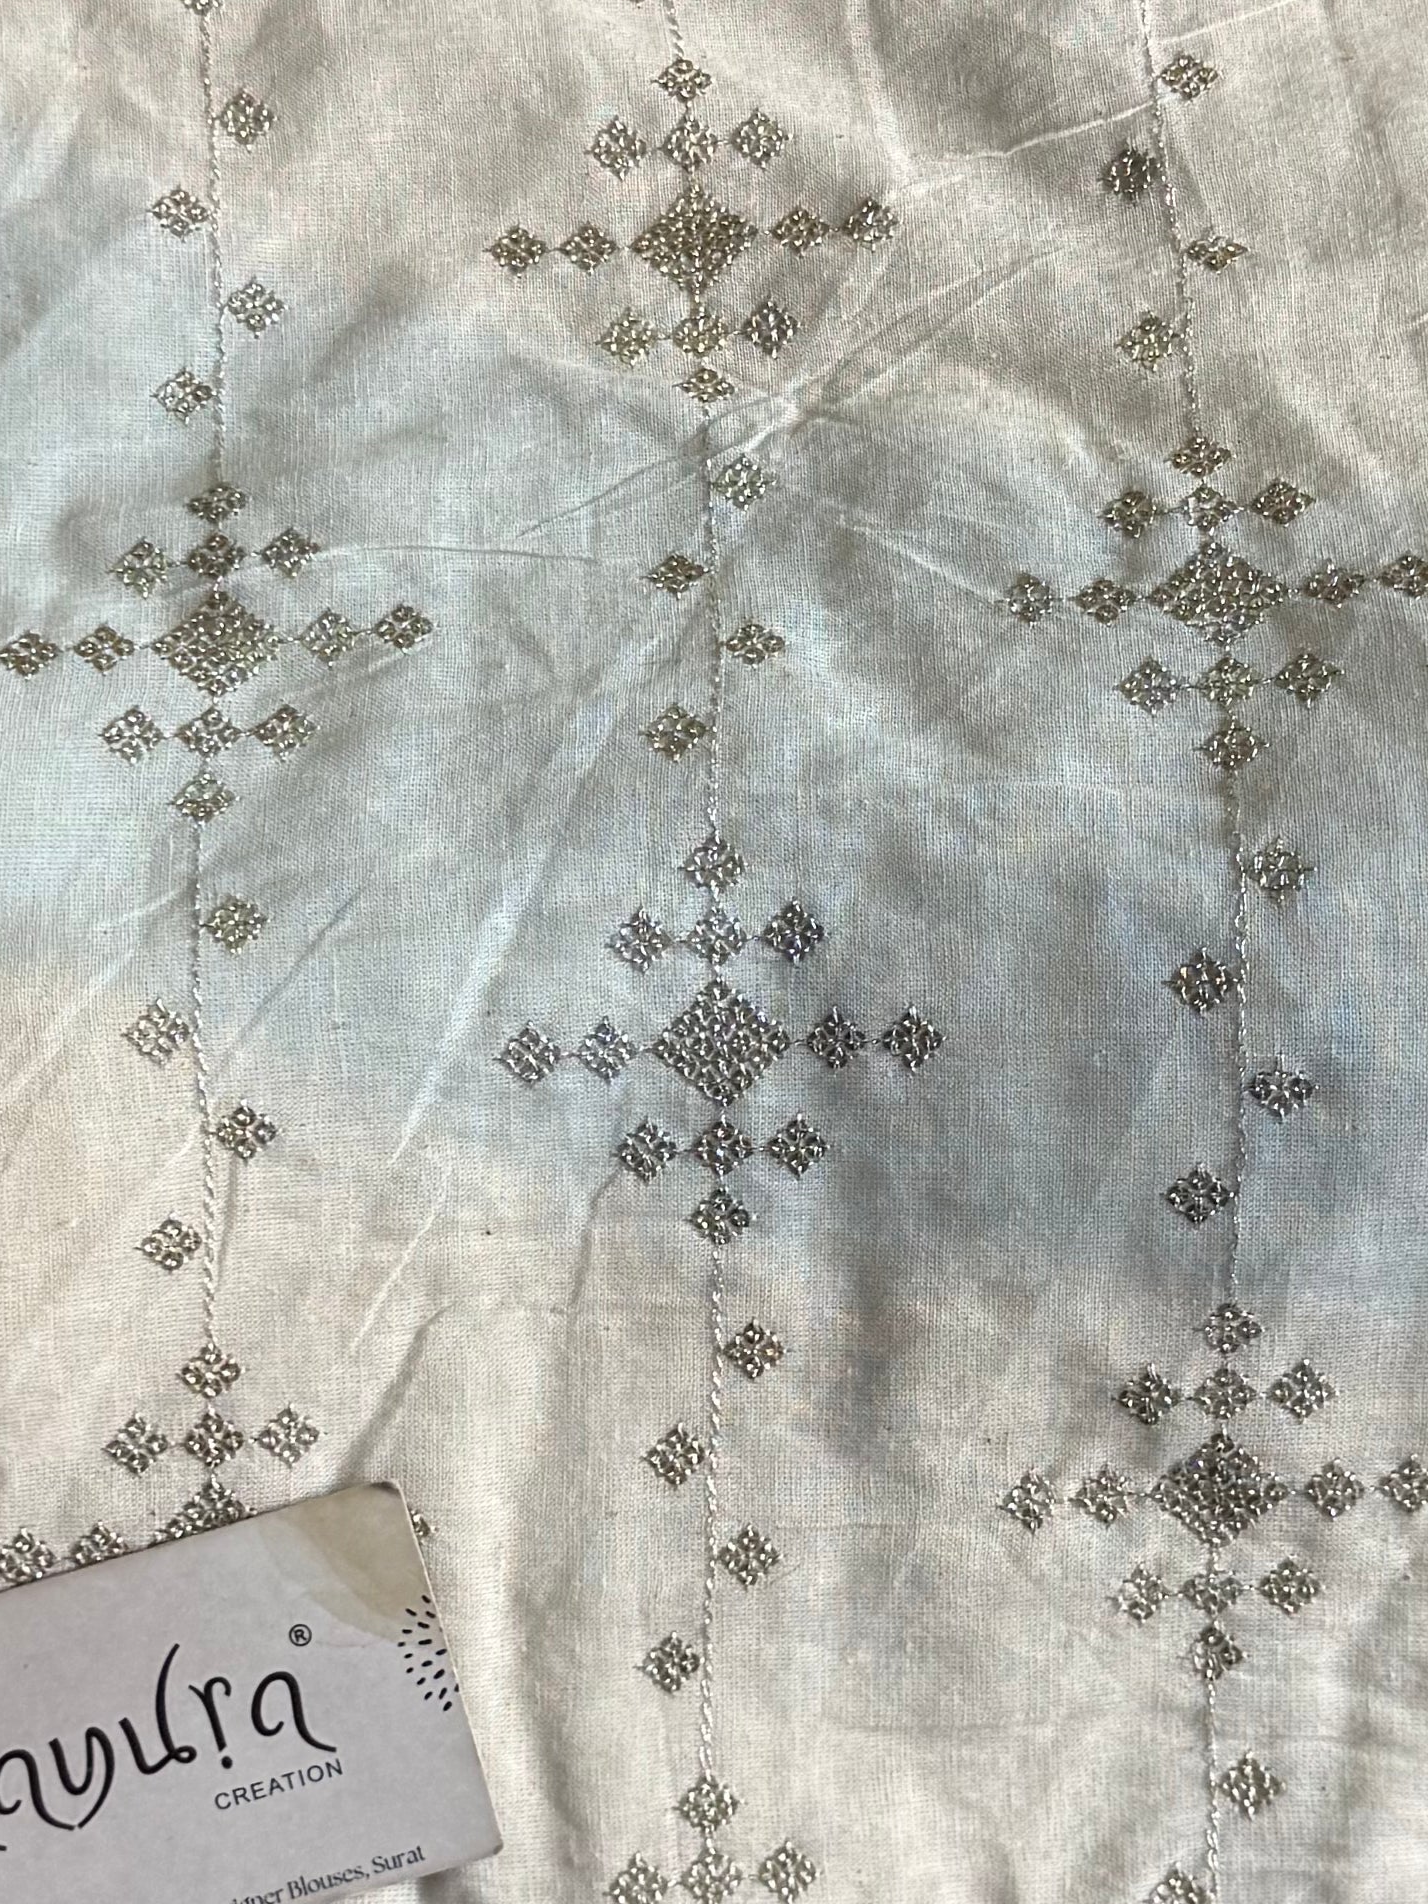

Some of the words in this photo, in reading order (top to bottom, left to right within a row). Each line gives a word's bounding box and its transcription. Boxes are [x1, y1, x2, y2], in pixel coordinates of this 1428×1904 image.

[213, 1757, 344, 1812] CREATION
[286, 1863, 370, 1900] Blouses,
[371, 1844, 426, 1875] Surat
